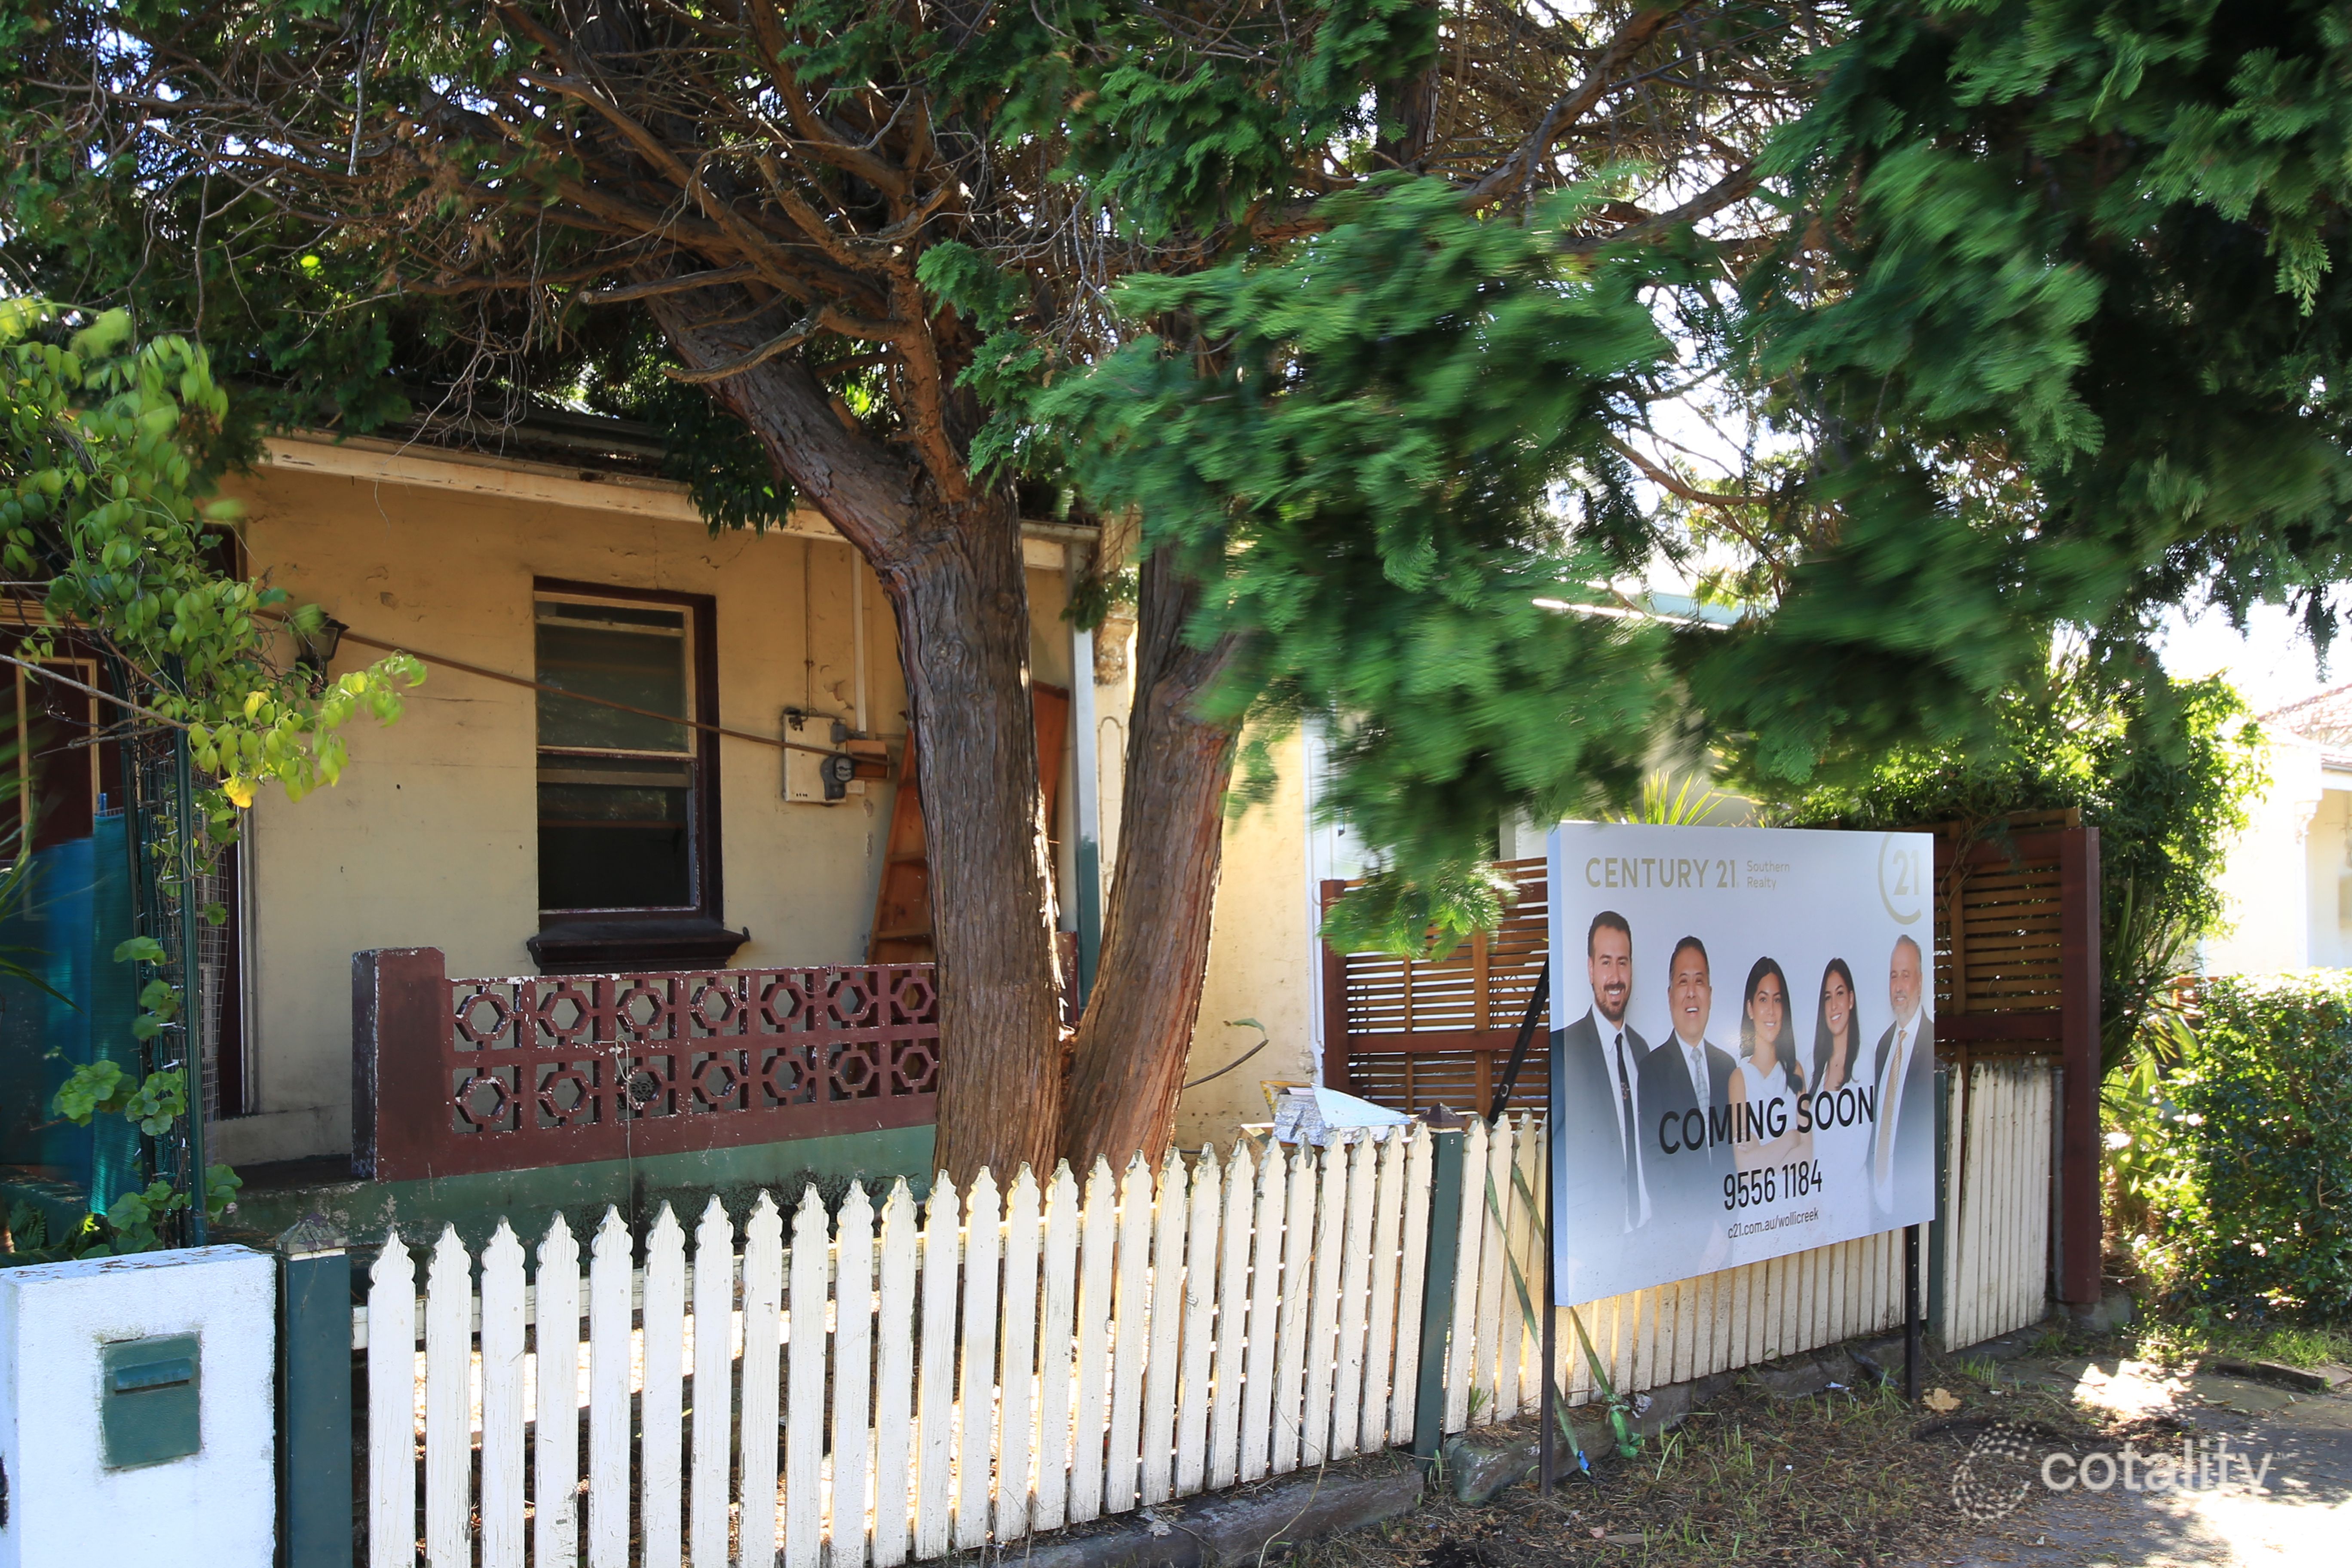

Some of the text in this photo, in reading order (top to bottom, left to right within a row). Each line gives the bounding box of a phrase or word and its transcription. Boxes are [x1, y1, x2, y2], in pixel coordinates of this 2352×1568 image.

[1585, 858, 1736, 888] CENTURY 21
[1747, 860, 1790, 873] Southern
[1747, 877, 1777, 891] Realty
[1660, 1085, 1874, 1154] COMING SOON
[1724, 1159, 1822, 1211] 9556 1184
[1728, 1207, 1819, 1239] c21.com.au/wollicreek
